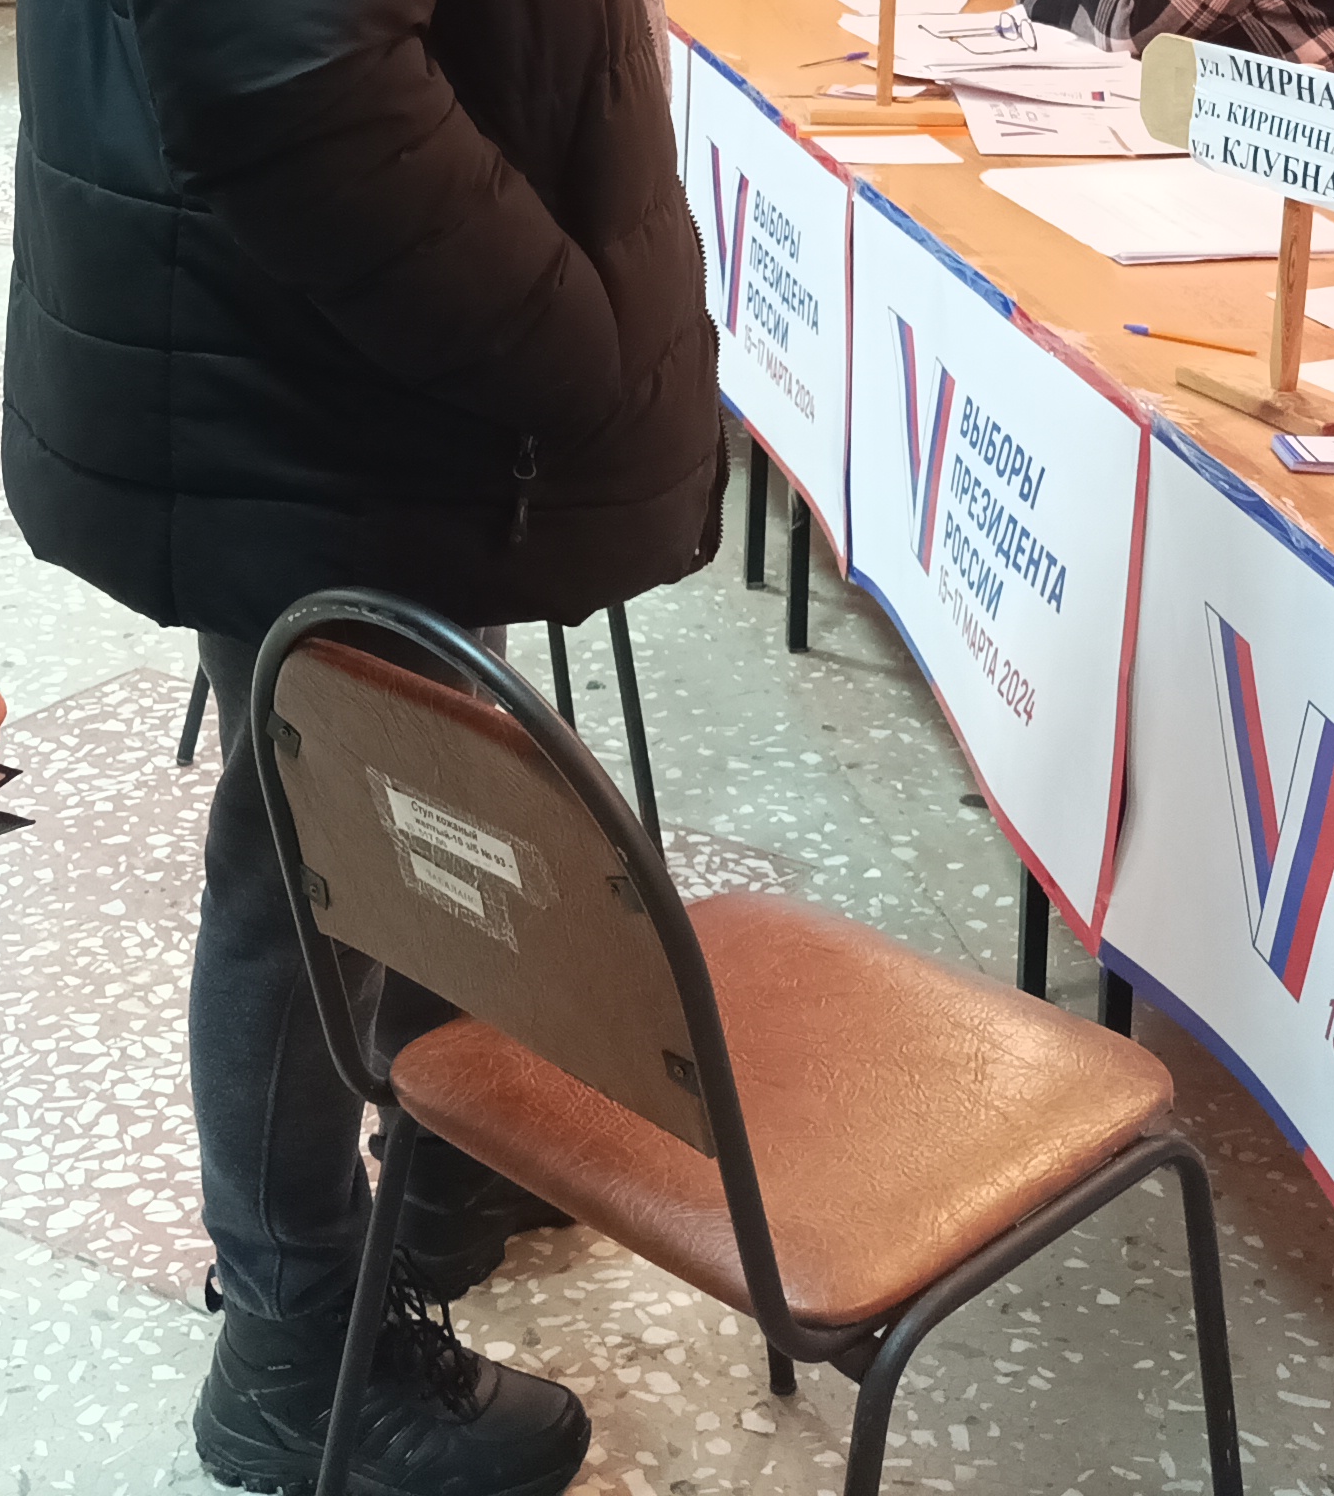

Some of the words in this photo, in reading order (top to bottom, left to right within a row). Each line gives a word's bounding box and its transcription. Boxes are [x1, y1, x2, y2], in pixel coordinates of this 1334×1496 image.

[1200, 56, 1225, 78] ул.
[1195, 98, 1220, 118] ул.
[1192, 138, 1215, 160] ул.
[753, 190, 801, 264] ВЫБОРЫ
[746, 281, 789, 353] РОССИИ
[749, 235, 819, 336] ПРЕЗИДЕНТА
[766, 348, 793, 404] МАРТА
[795, 378, 815, 424] 2024
[959, 394, 1045, 511] ВЫБОРЫ
[943, 509, 1004, 622] РОССИИ
[950, 453, 1067, 615] ПРЕЗИДЕНТА
[962, 612, 999, 688] МАРТА
[997, 658, 1037, 728] 2024
[410, 800, 434, 820] Стул
[435, 813, 478, 841] кожаный
